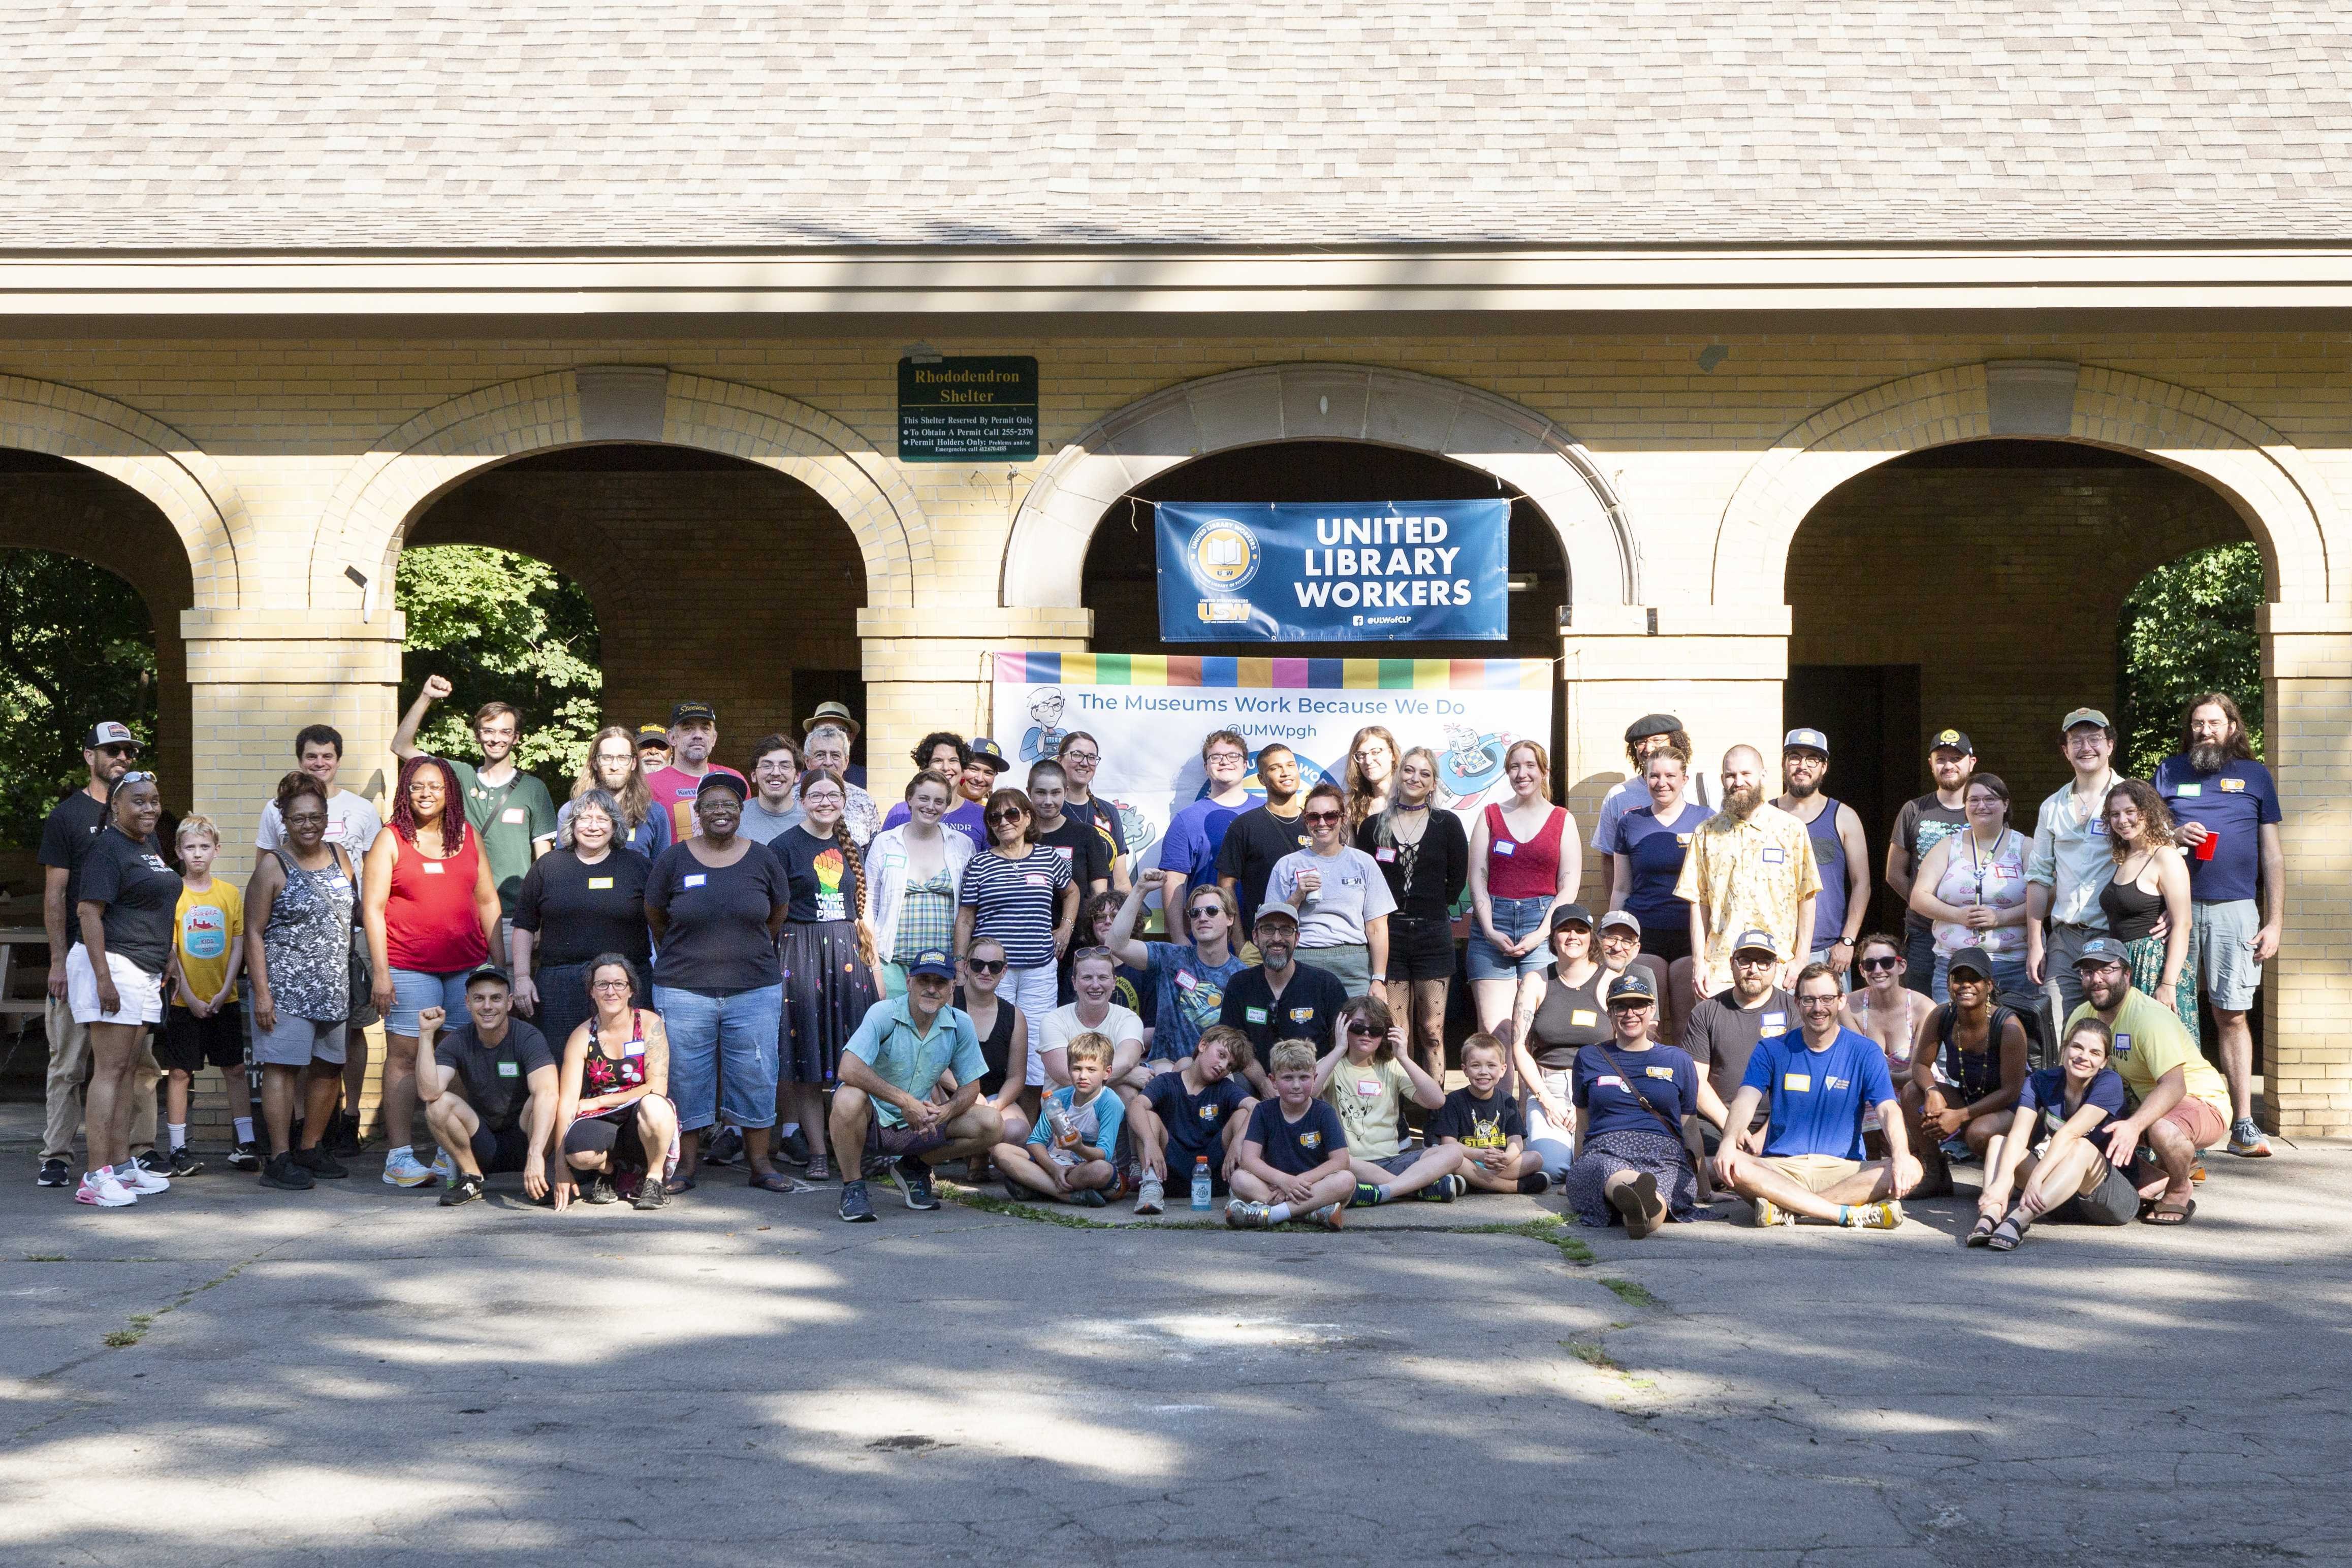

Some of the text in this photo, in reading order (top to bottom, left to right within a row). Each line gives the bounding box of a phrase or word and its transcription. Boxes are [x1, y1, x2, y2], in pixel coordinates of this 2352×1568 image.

[915, 370, 1020, 382] Rhododendron
[941, 390, 994, 402] Shelter
[980, 417, 988, 425] By
[1016, 417, 1033, 425] Only
[967, 439, 986, 447] Only:
[1191, 522, 1257, 550] UNITED LIBRARY WORKERS
[1317, 517, 1448, 545] UNITED
[1305, 547, 1461, 576] LIBRARY
[1294, 579, 1472, 607] WORKERS
[1198, 603, 1252, 621] USW
[1367, 616, 1412, 624] @ULWofCLP
[1078, 694, 1465, 715] The Museums Work Because We Do
[1226, 724, 1317, 740] @UMWpgh
[815, 892, 845, 901] MADE
[817, 901, 845, 910] WITH
[816, 910, 846, 920] PRIDE
[1290, 1009, 1314, 1020] USW
[1465, 1135, 1506, 1147] STEELERS
